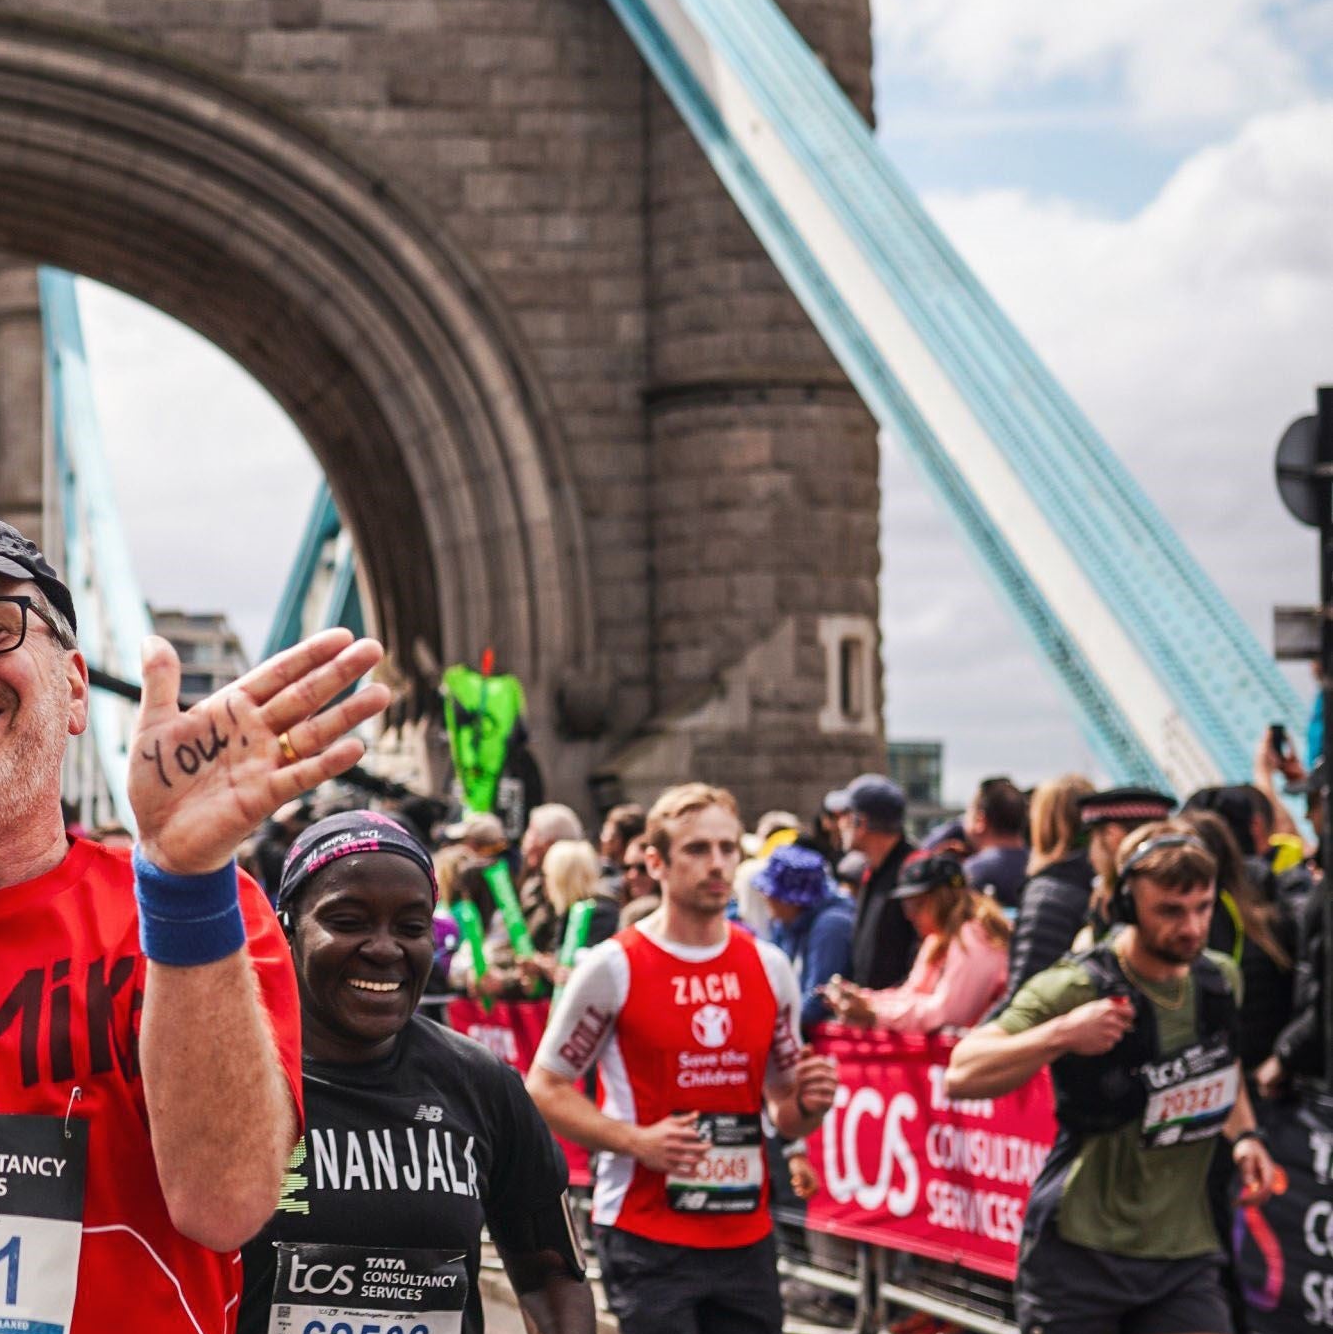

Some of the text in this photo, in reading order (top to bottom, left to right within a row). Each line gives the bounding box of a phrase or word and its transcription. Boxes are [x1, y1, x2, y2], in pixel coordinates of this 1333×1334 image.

[671, 971, 741, 1005] ZACH
[559, 1005, 612, 1071] ROLL
[678, 1048, 749, 1069] Save the
[677, 1069, 748, 1088] Children
[822, 1085, 919, 1217] tcs
[926, 1180, 1023, 1246] SERVICES
[288, 1254, 356, 1295] tcs
[365, 1257, 406, 1271] TATA
[360, 1285, 423, 1301] SERVICES
[362, 1271, 457, 1288] CONSULTANCY
